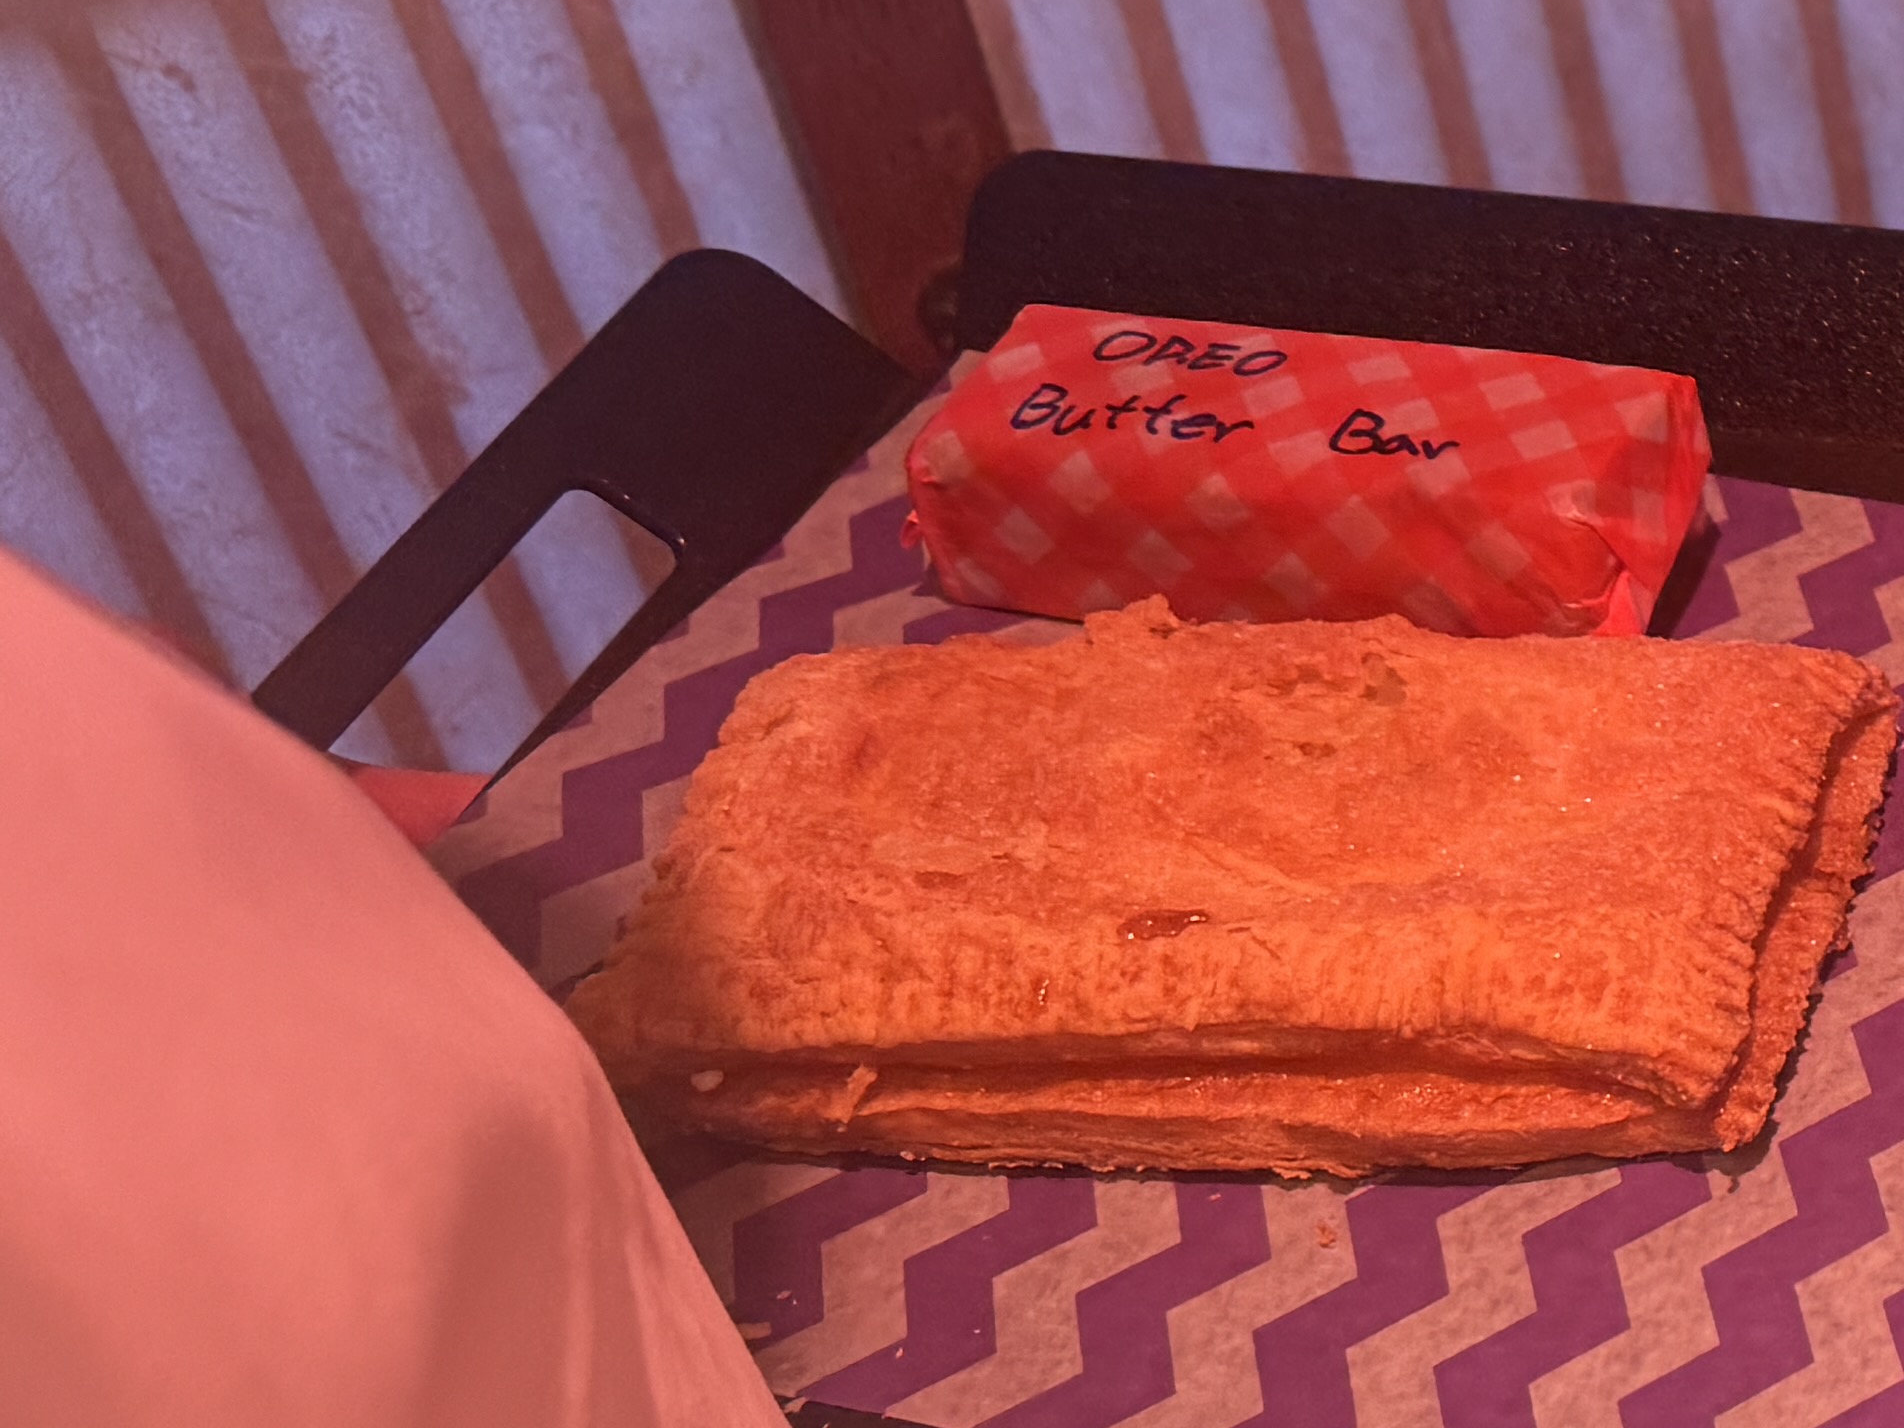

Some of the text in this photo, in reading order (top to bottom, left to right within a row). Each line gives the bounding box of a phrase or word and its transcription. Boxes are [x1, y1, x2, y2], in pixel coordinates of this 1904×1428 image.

[1092, 329, 1288, 377] OREO
[1010, 382, 1461, 461] Butter Bar
